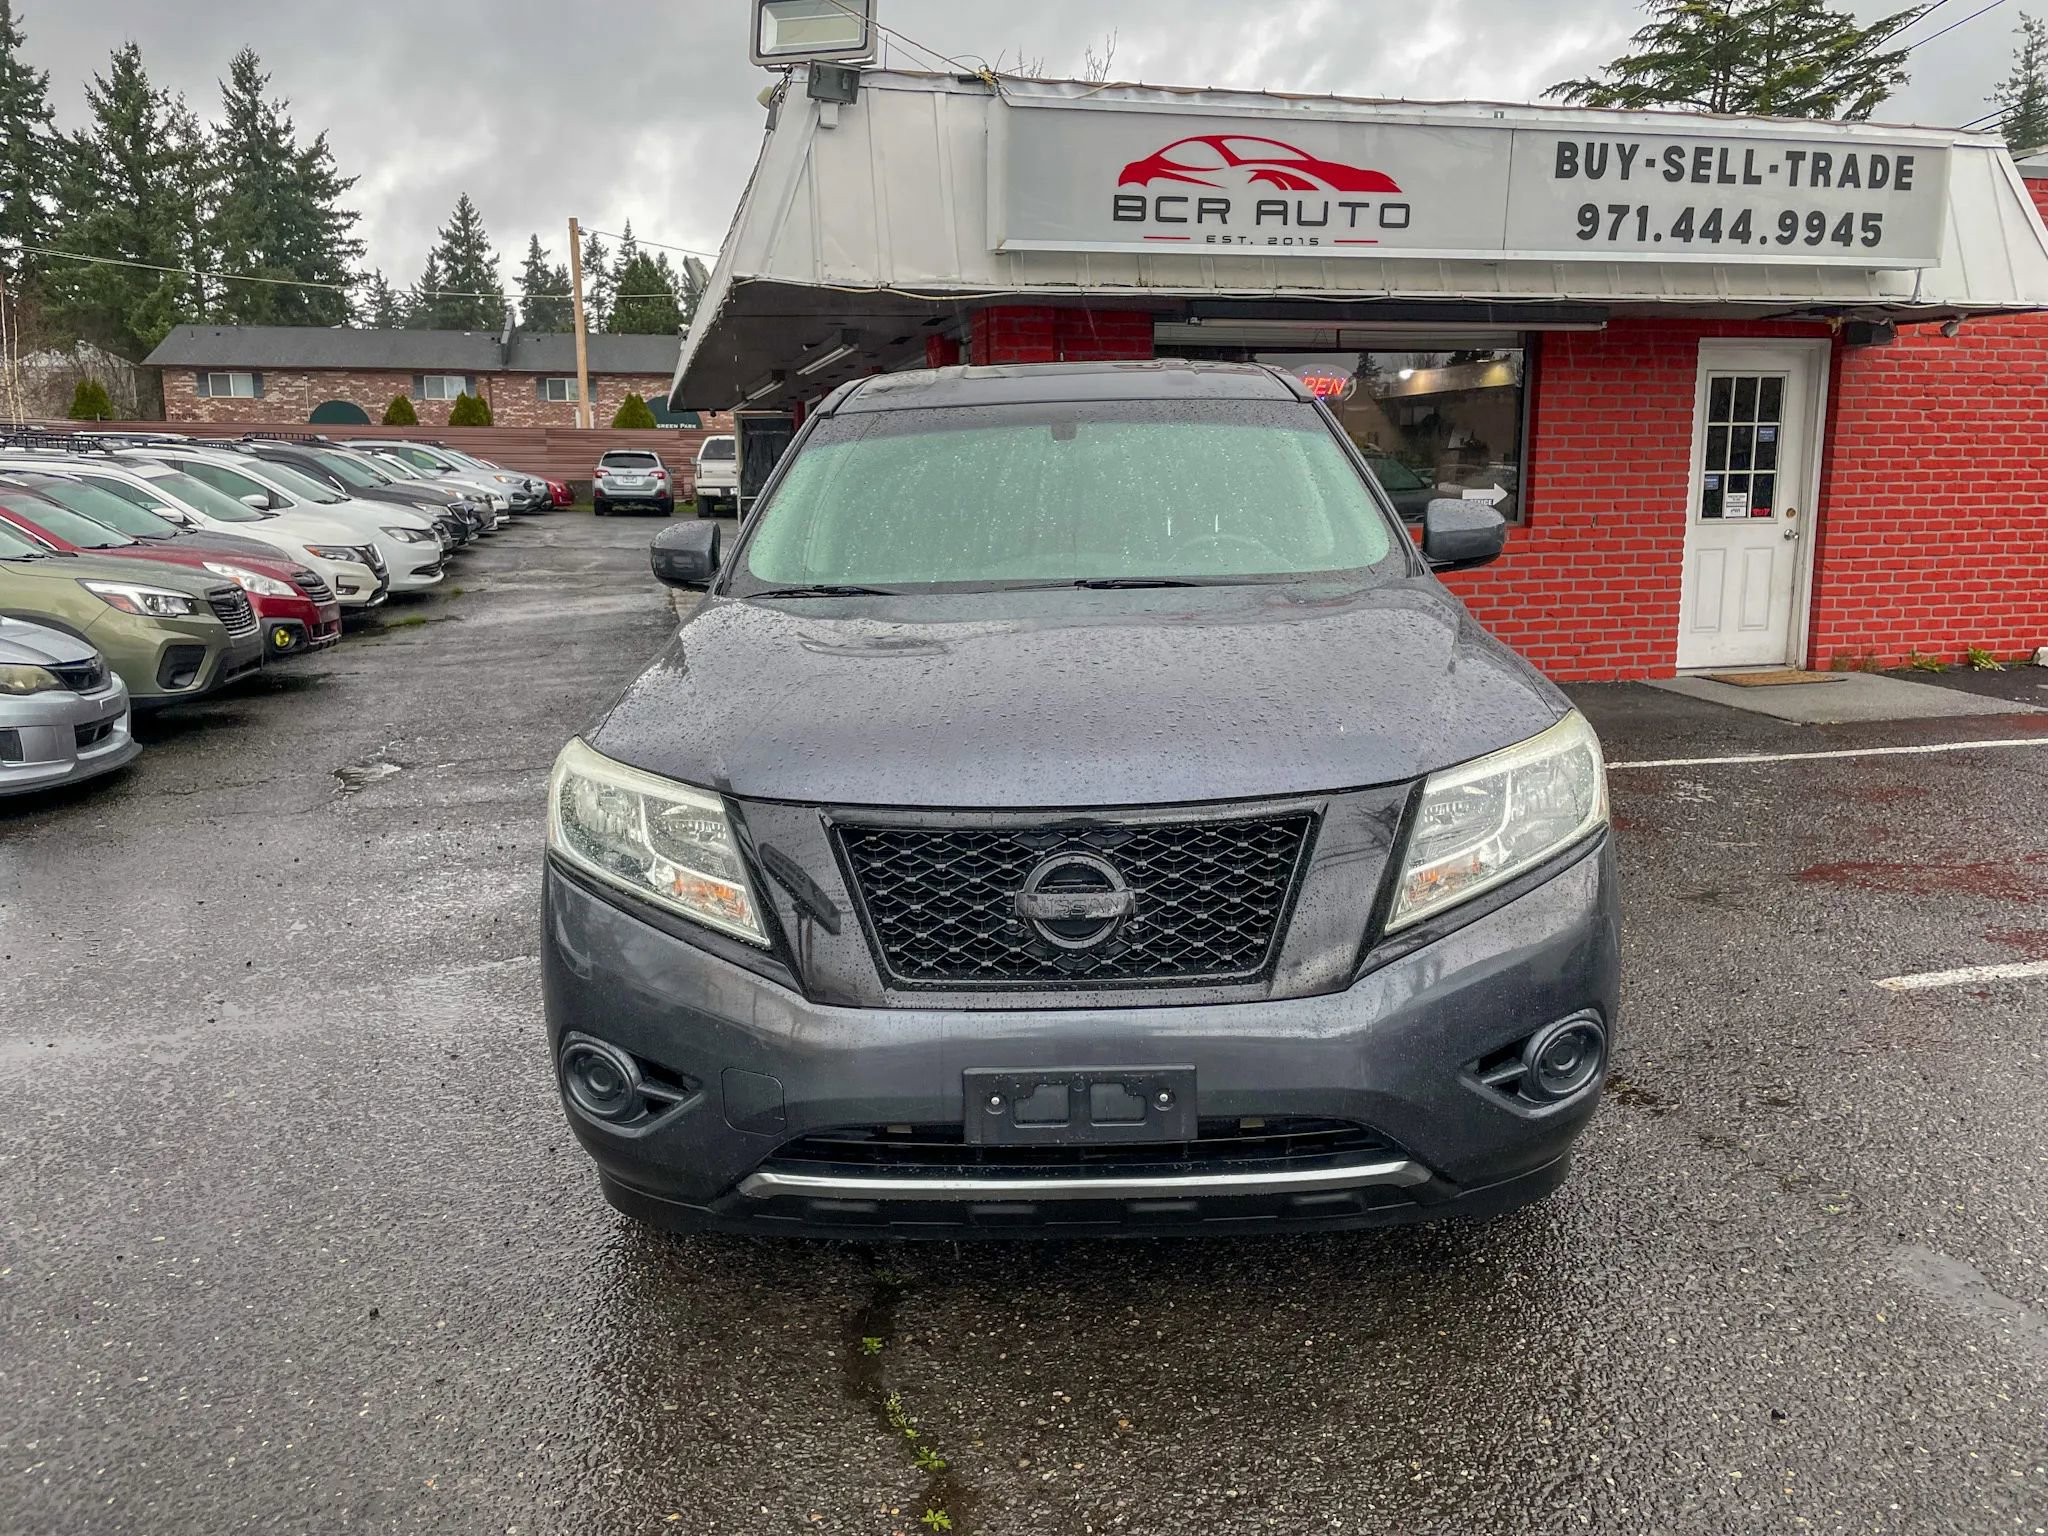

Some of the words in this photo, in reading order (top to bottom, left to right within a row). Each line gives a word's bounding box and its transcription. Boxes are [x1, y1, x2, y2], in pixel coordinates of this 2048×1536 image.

[1555, 141, 1914, 191] BUY-SELL-TRADE
[1113, 194, 1231, 225] BCR
[1255, 200, 1410, 228] AUTO
[1576, 203, 1883, 248] 971.444.9945
[1206, 235, 1254, 246] EST.
[1267, 237, 1319, 246] 2015
[1304, 377, 1347, 395] PEN
[1026, 897, 1121, 917] NISSAN
